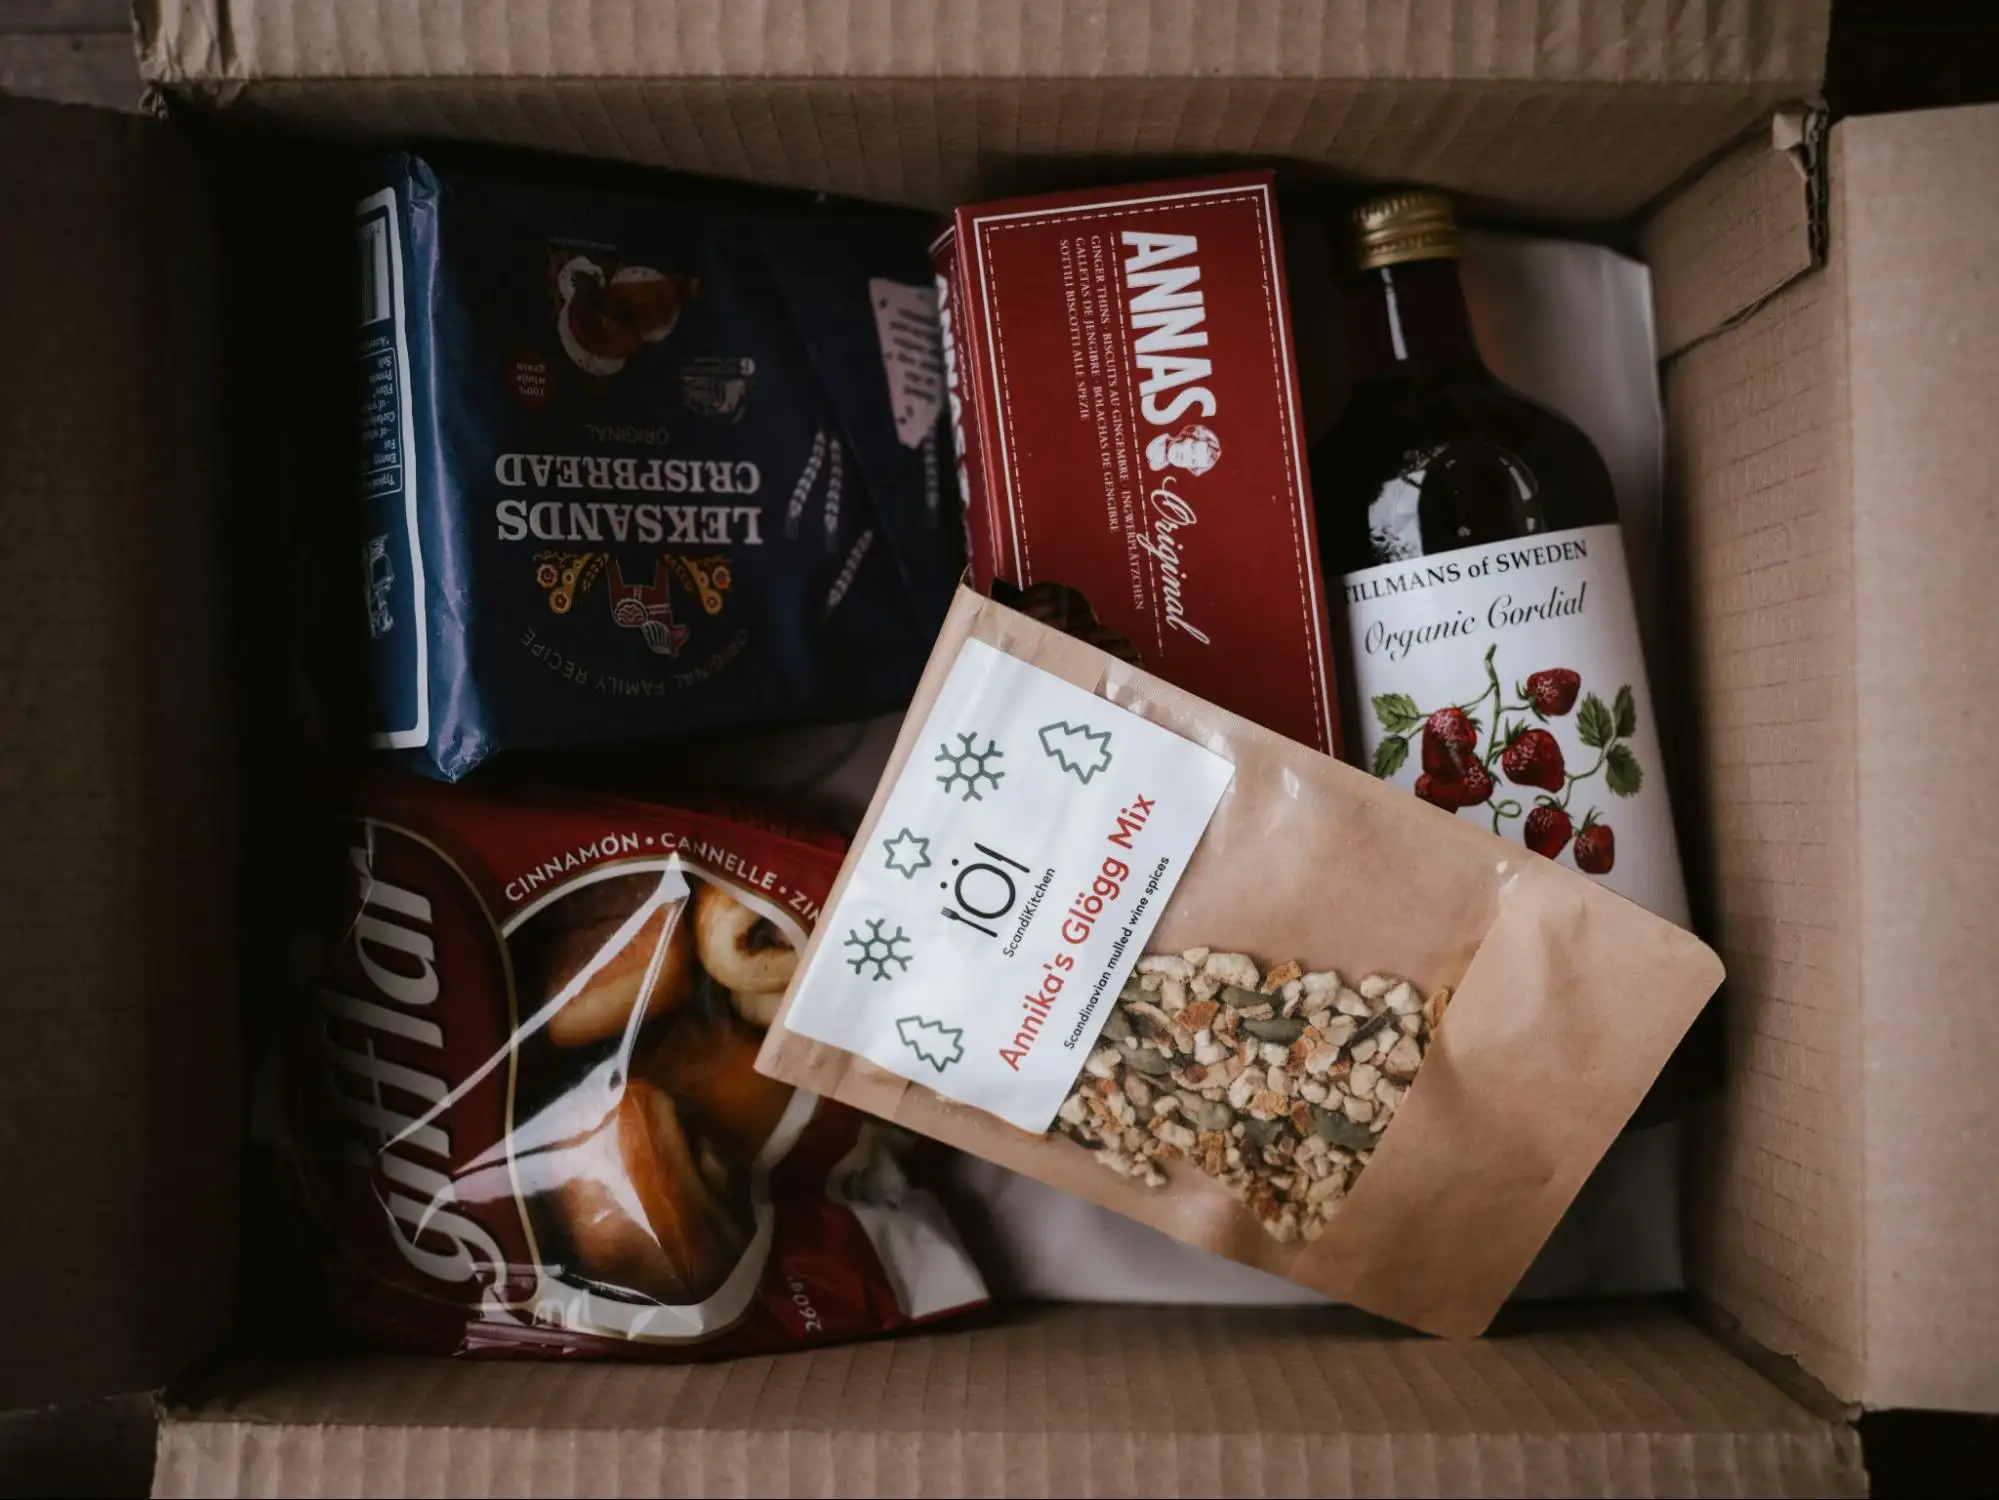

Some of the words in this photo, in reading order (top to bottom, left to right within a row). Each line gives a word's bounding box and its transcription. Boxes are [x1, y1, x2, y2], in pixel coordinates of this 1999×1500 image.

[1075, 236, 1091, 298] GALLETAS
[1091, 235, 1106, 284] GINGER
[1065, 290, 1082, 348] BISCOTTI
[1082, 300, 1095, 319] DE
[1097, 284, 1111, 324] THINS
[1121, 231, 1217, 425] ANNAS
[1072, 349, 1086, 380] ALLE
[1083, 320, 1101, 377] JENGIBRE
[1103, 332, 1118, 387] BISCUITS
[1077, 380, 1091, 421] SPEZIE
[1092, 386, 1109, 451] BOLACHAS
[1109, 388, 1121, 409] AU
[583, 424, 669, 445] ORIGINAL
[1101, 452, 1112, 471] DE
[1112, 411, 1130, 482] GINGEMBRE
[494, 453, 762, 495] CRISPBREAD
[495, 499, 764, 545] LEKSANDS
[1103, 472, 1121, 534] GENGIBRE
[1136, 475, 1212, 646] Original
[1468, 556, 1491, 579] of
[1496, 539, 1589, 574] SWEDEN
[1364, 609, 1476, 662] Organic
[1488, 582, 1588, 631] Cordial
[519, 627, 590, 686] RECIPE
[596, 674, 666, 697] FAMILY
[660, 831, 779, 894] CANNELLE
[998, 952, 1075, 1073] Annika's
[1061, 855, 1131, 946] Glögg
[1107, 792, 1157, 850] Mix
[1002, 867, 1056, 959] ScandiKitchen
[1063, 970, 1112, 1050] Scandinavian
[1107, 925, 1134, 970] mulled
[1128, 894, 1150, 926] wine
[1145, 855, 1170, 897] spices
